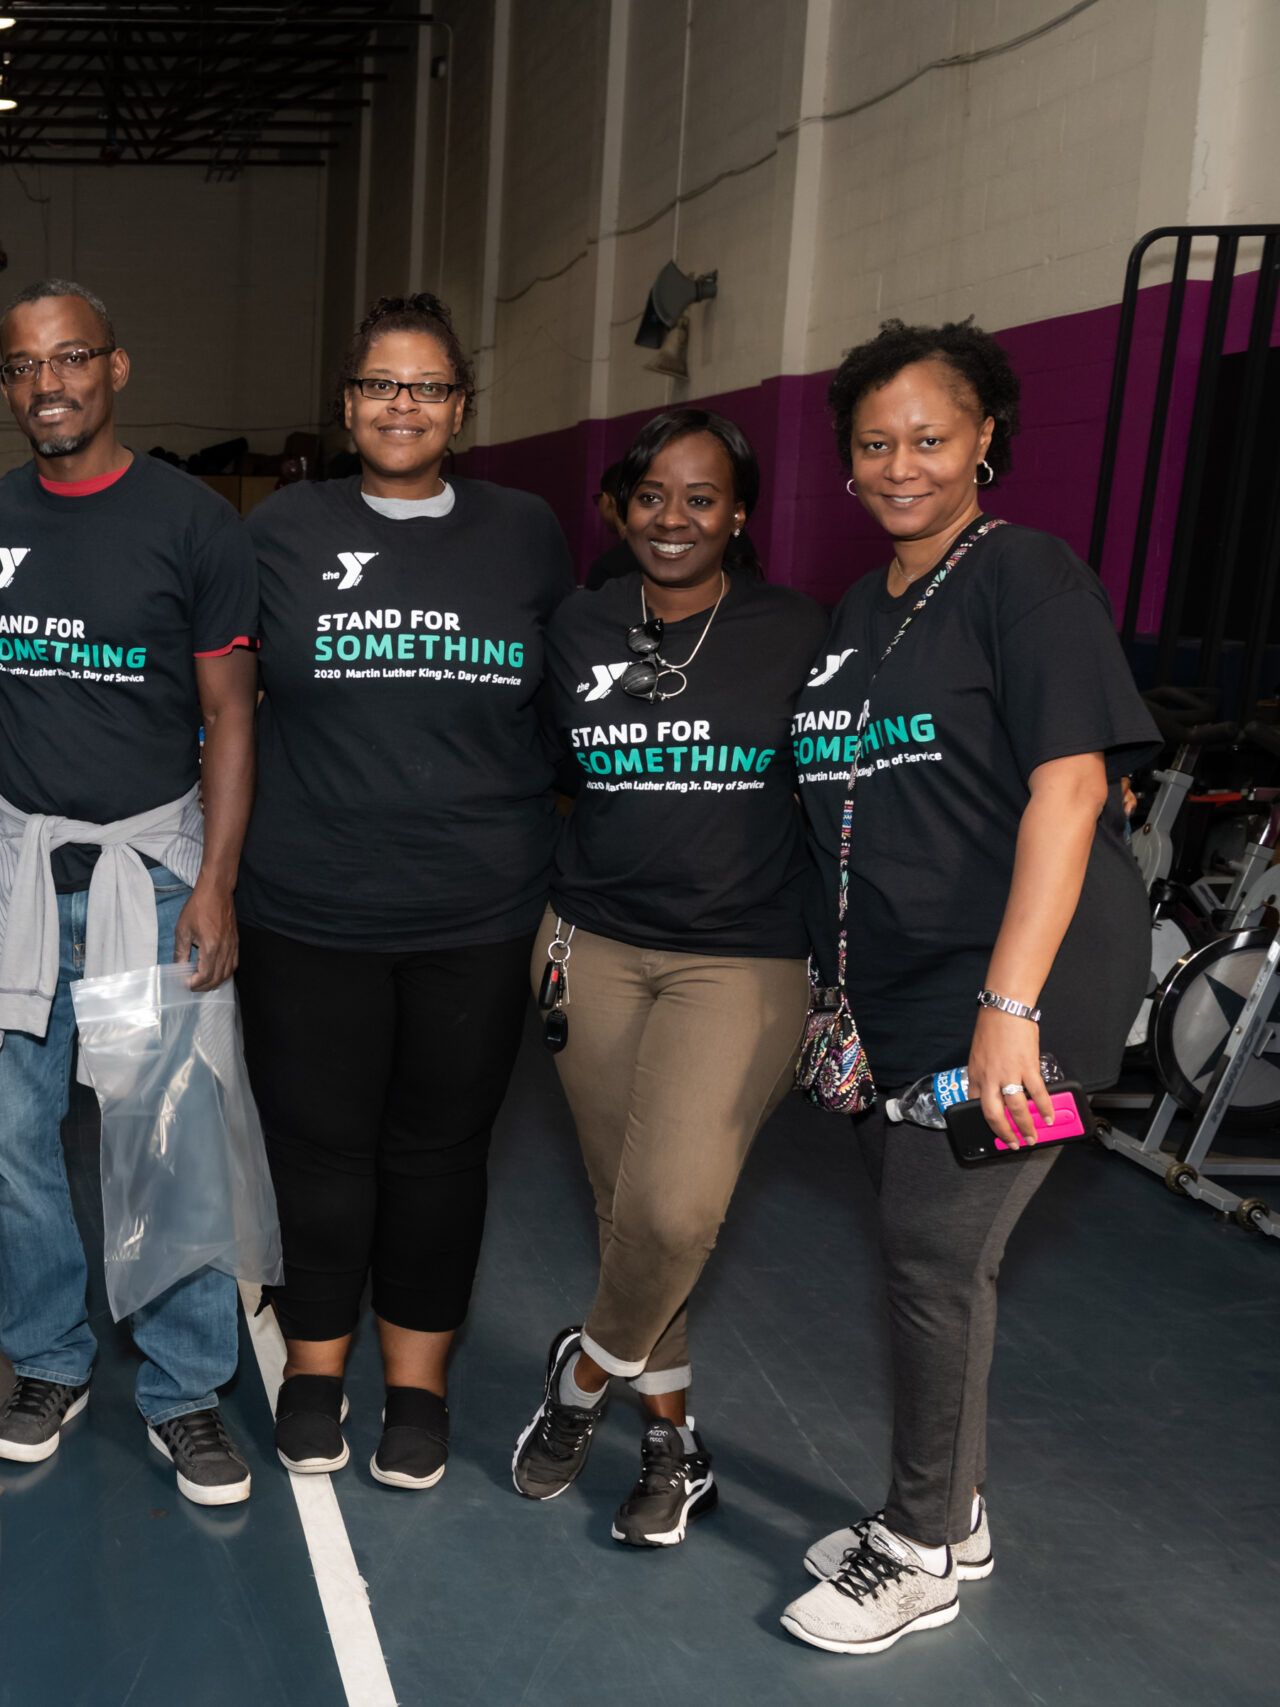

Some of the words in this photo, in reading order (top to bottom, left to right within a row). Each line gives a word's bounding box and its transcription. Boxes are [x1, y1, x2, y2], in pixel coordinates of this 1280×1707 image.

[323, 571, 340, 581] the
[337, 552, 376, 590] Y
[45, 617, 85, 638] FOR
[317, 609, 402, 631] STAND
[411, 610, 460, 631] FOR
[315, 634, 524, 668] SOMETHING
[30, 667, 57, 677] Luther
[83, 670, 102, 682] Day
[104, 674, 115, 682] of
[116, 673, 144, 683] Service
[314, 669, 341, 679] 2020
[346, 668, 380, 679] Martin
[383, 668, 416, 679] Luther
[419, 667, 441, 681] King
[443, 670, 456, 680] Jr.
[458, 671, 477, 684] Day
[479, 673, 491, 683] of
[492, 674, 522, 686] Service
[576, 682, 590, 693] the
[571, 723, 648, 748] STAND
[657, 720, 711, 742] FOR
[576, 745, 776, 775] SOMETHING
[892, 754, 903, 765] of
[904, 751, 942, 763] Service
[633, 781, 664, 791] Luther
[665, 781, 688, 793] King
[689, 781, 701, 791] Jr.
[703, 781, 722, 793] Day
[725, 781, 736, 791] of
[737, 780, 765, 791] Service
